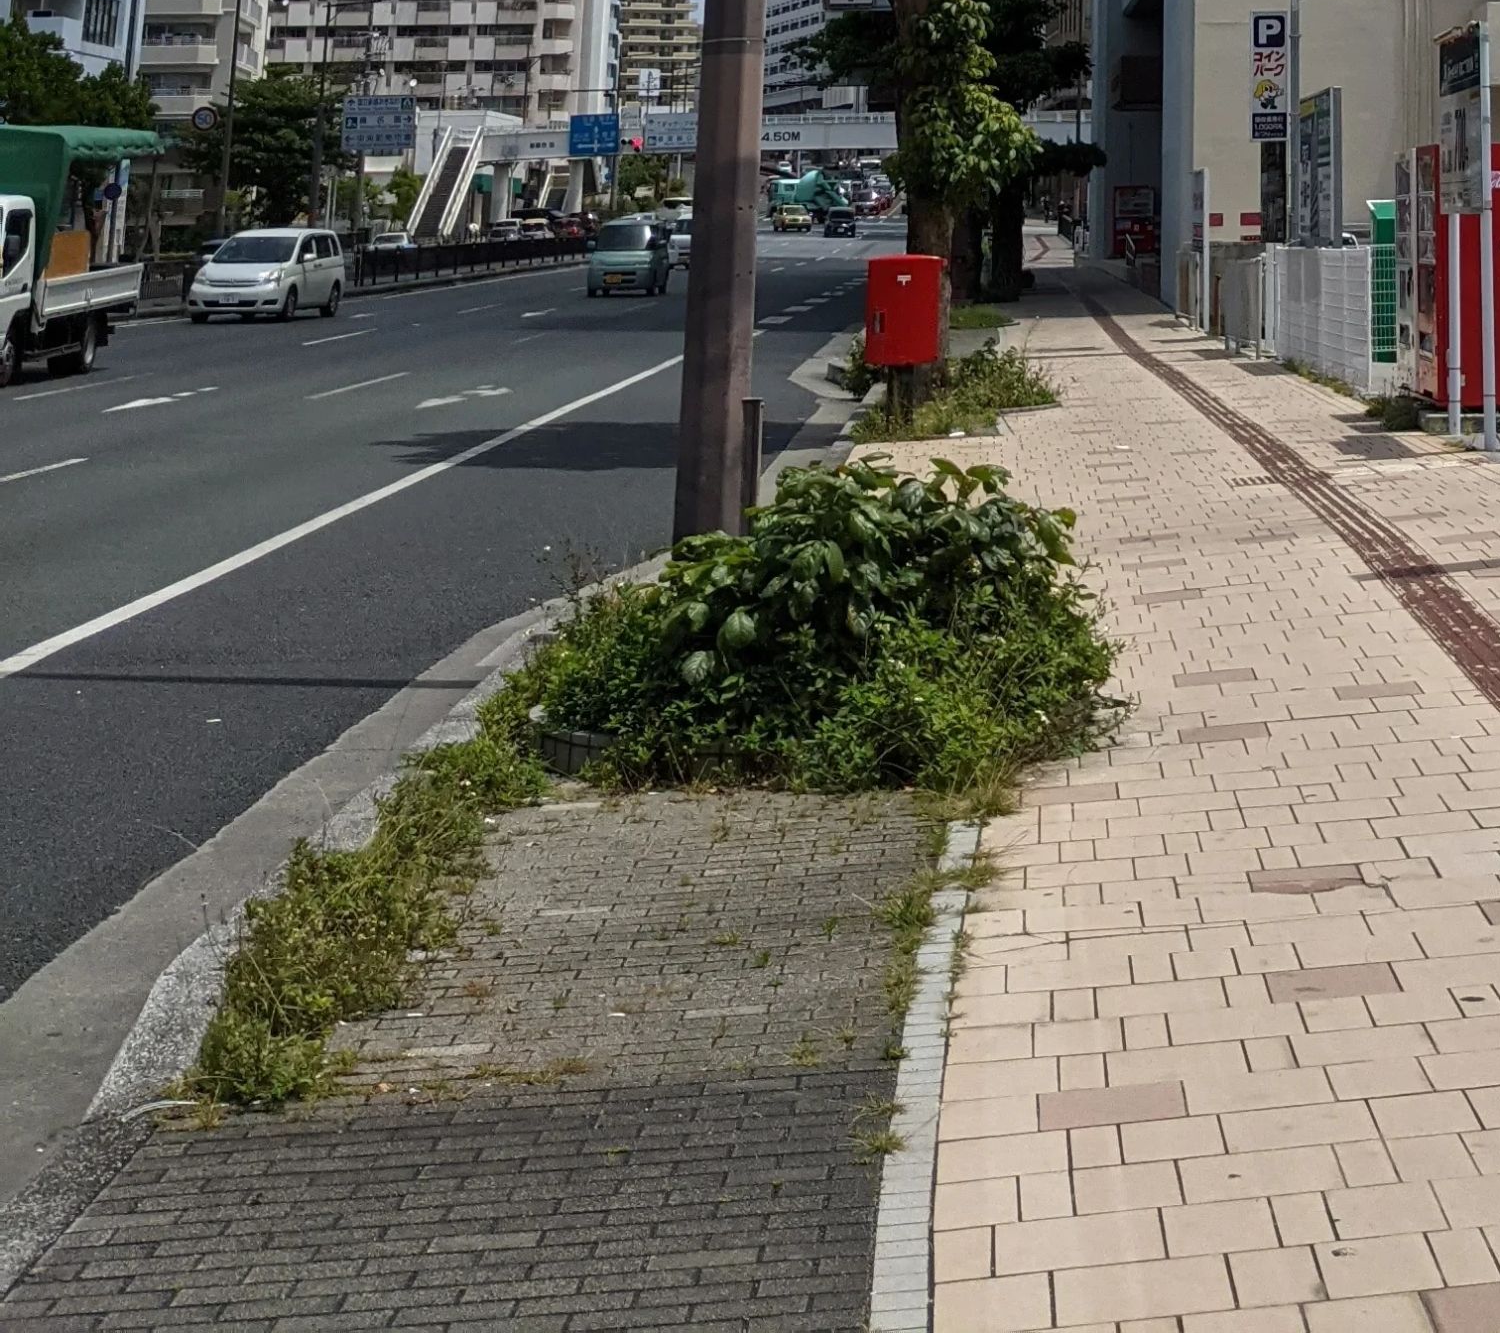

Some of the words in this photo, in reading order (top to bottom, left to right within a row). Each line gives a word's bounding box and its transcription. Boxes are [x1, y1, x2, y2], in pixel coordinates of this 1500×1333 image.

[1258, 18, 1282, 45] P
[1253, 50, 1285, 63] コイン
